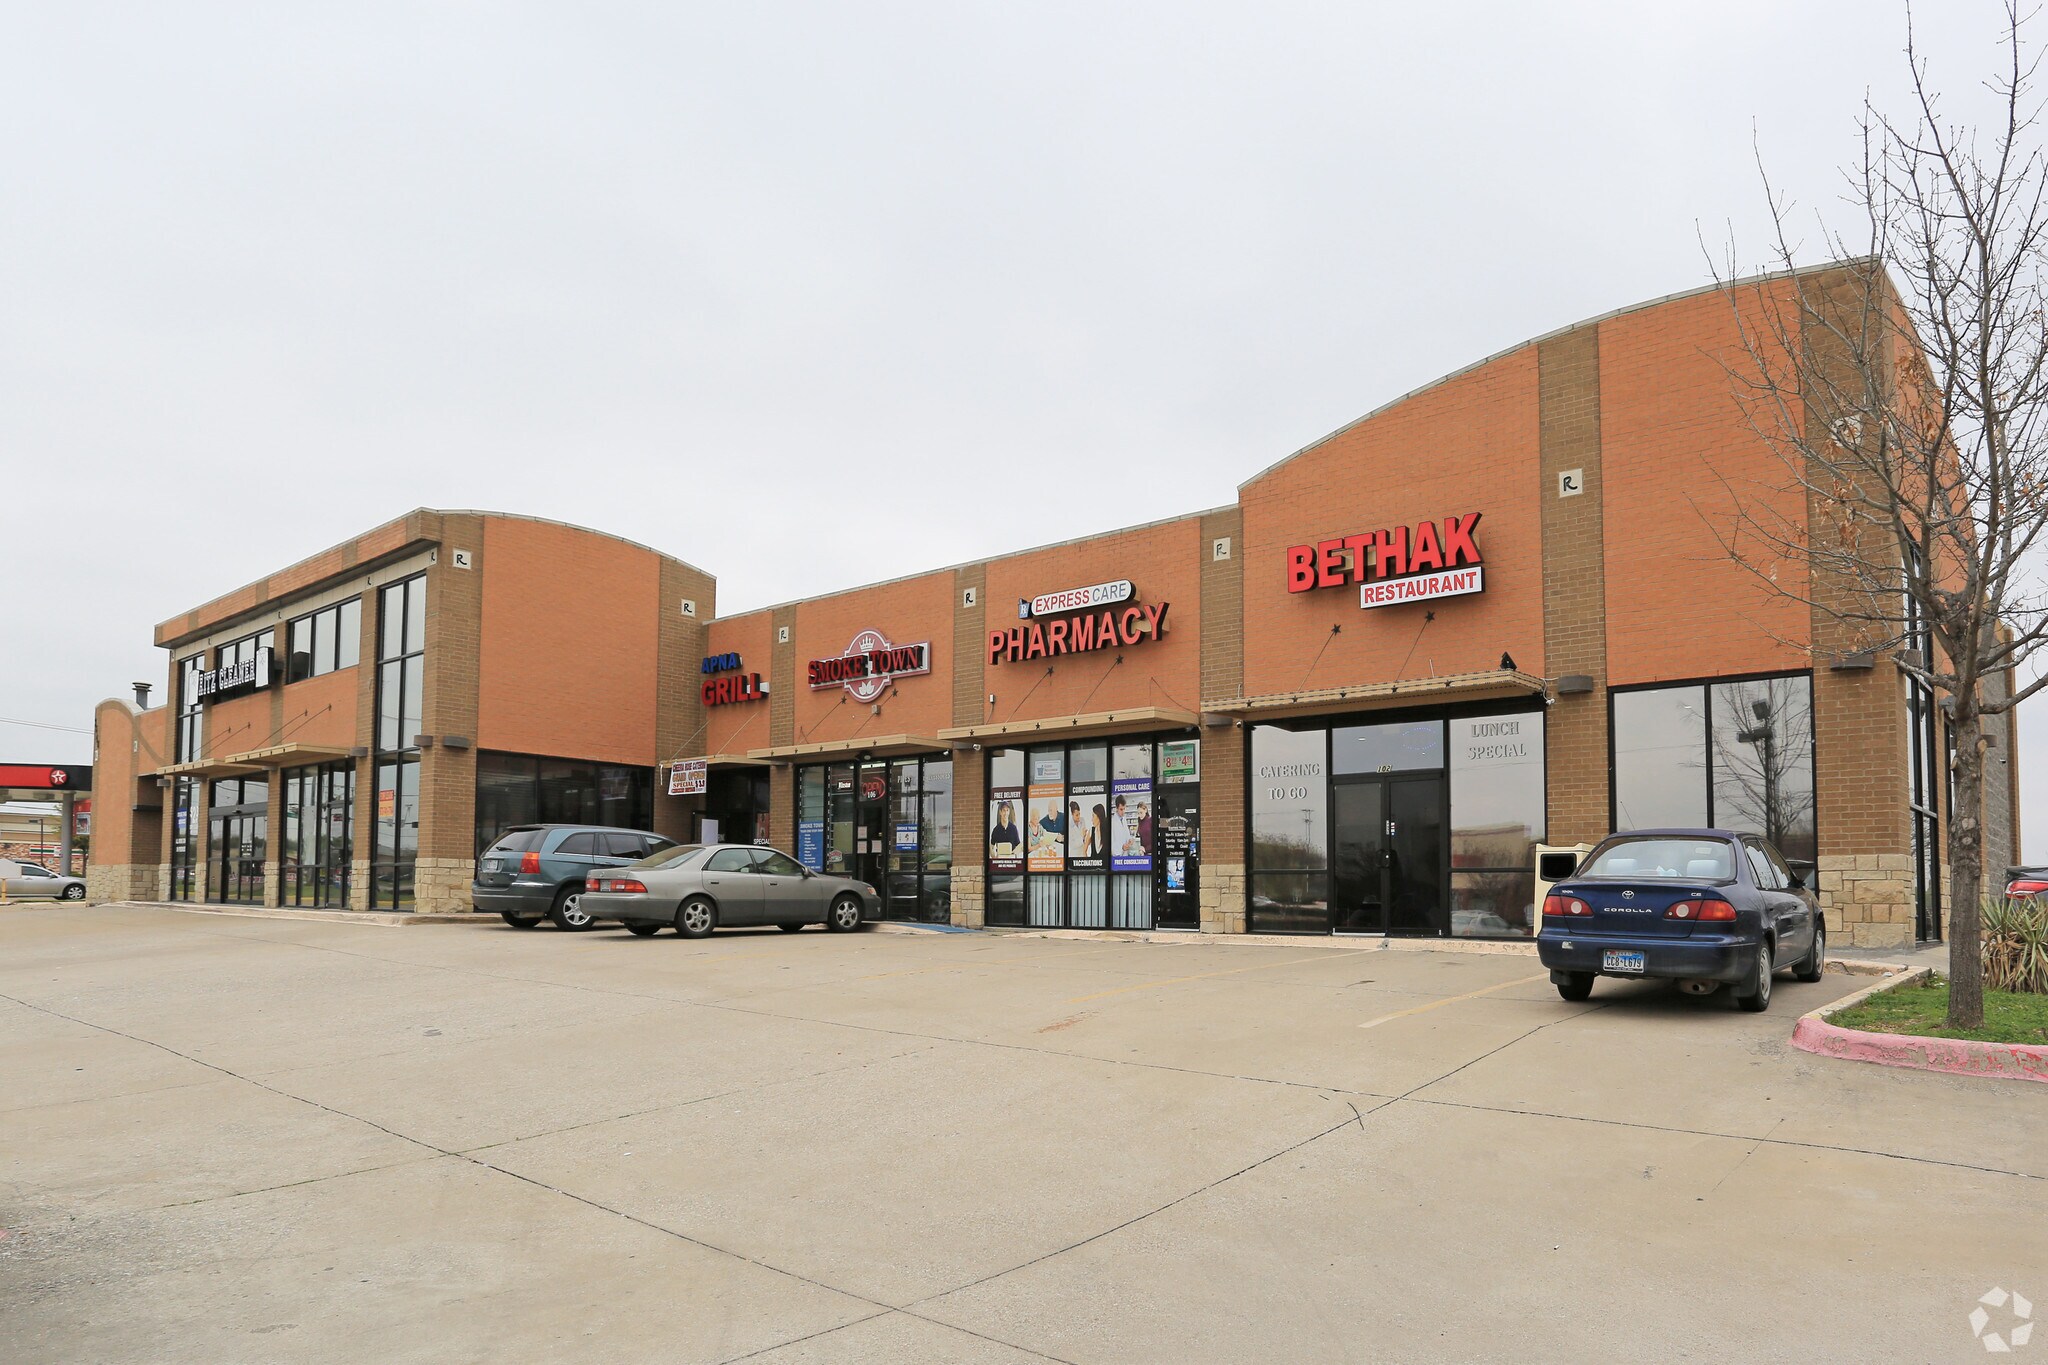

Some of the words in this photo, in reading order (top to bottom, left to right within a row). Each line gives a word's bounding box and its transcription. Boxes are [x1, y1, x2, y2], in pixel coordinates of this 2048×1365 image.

[1287, 512, 1482, 594] BETHAK
[1036, 590, 1090, 612] EXPRESS
[1092, 583, 1126, 602] CARE
[1364, 572, 1476, 604] RESTAURANT
[988, 602, 1168, 665] PHARMACY
[701, 652, 739, 674] APNA
[808, 655, 866, 684] SMOKE
[870, 646, 922, 674] TOWN
[198, 669, 216, 696] RITZ
[219, 658, 255, 690] CLEANER
[701, 672, 762, 708] GRILL
[1472, 722, 1520, 738] LUNCH
[1468, 744, 1526, 760] SPECIAL
[1260, 763, 1320, 778] CATERING
[1377, 764, 1392, 773] 102
[1072, 785, 1104, 794] COMPOUNDING
[1114, 784, 1138, 792] PERSONAL
[1268, 787, 1284, 800] TO
[1289, 786, 1307, 800] GO
